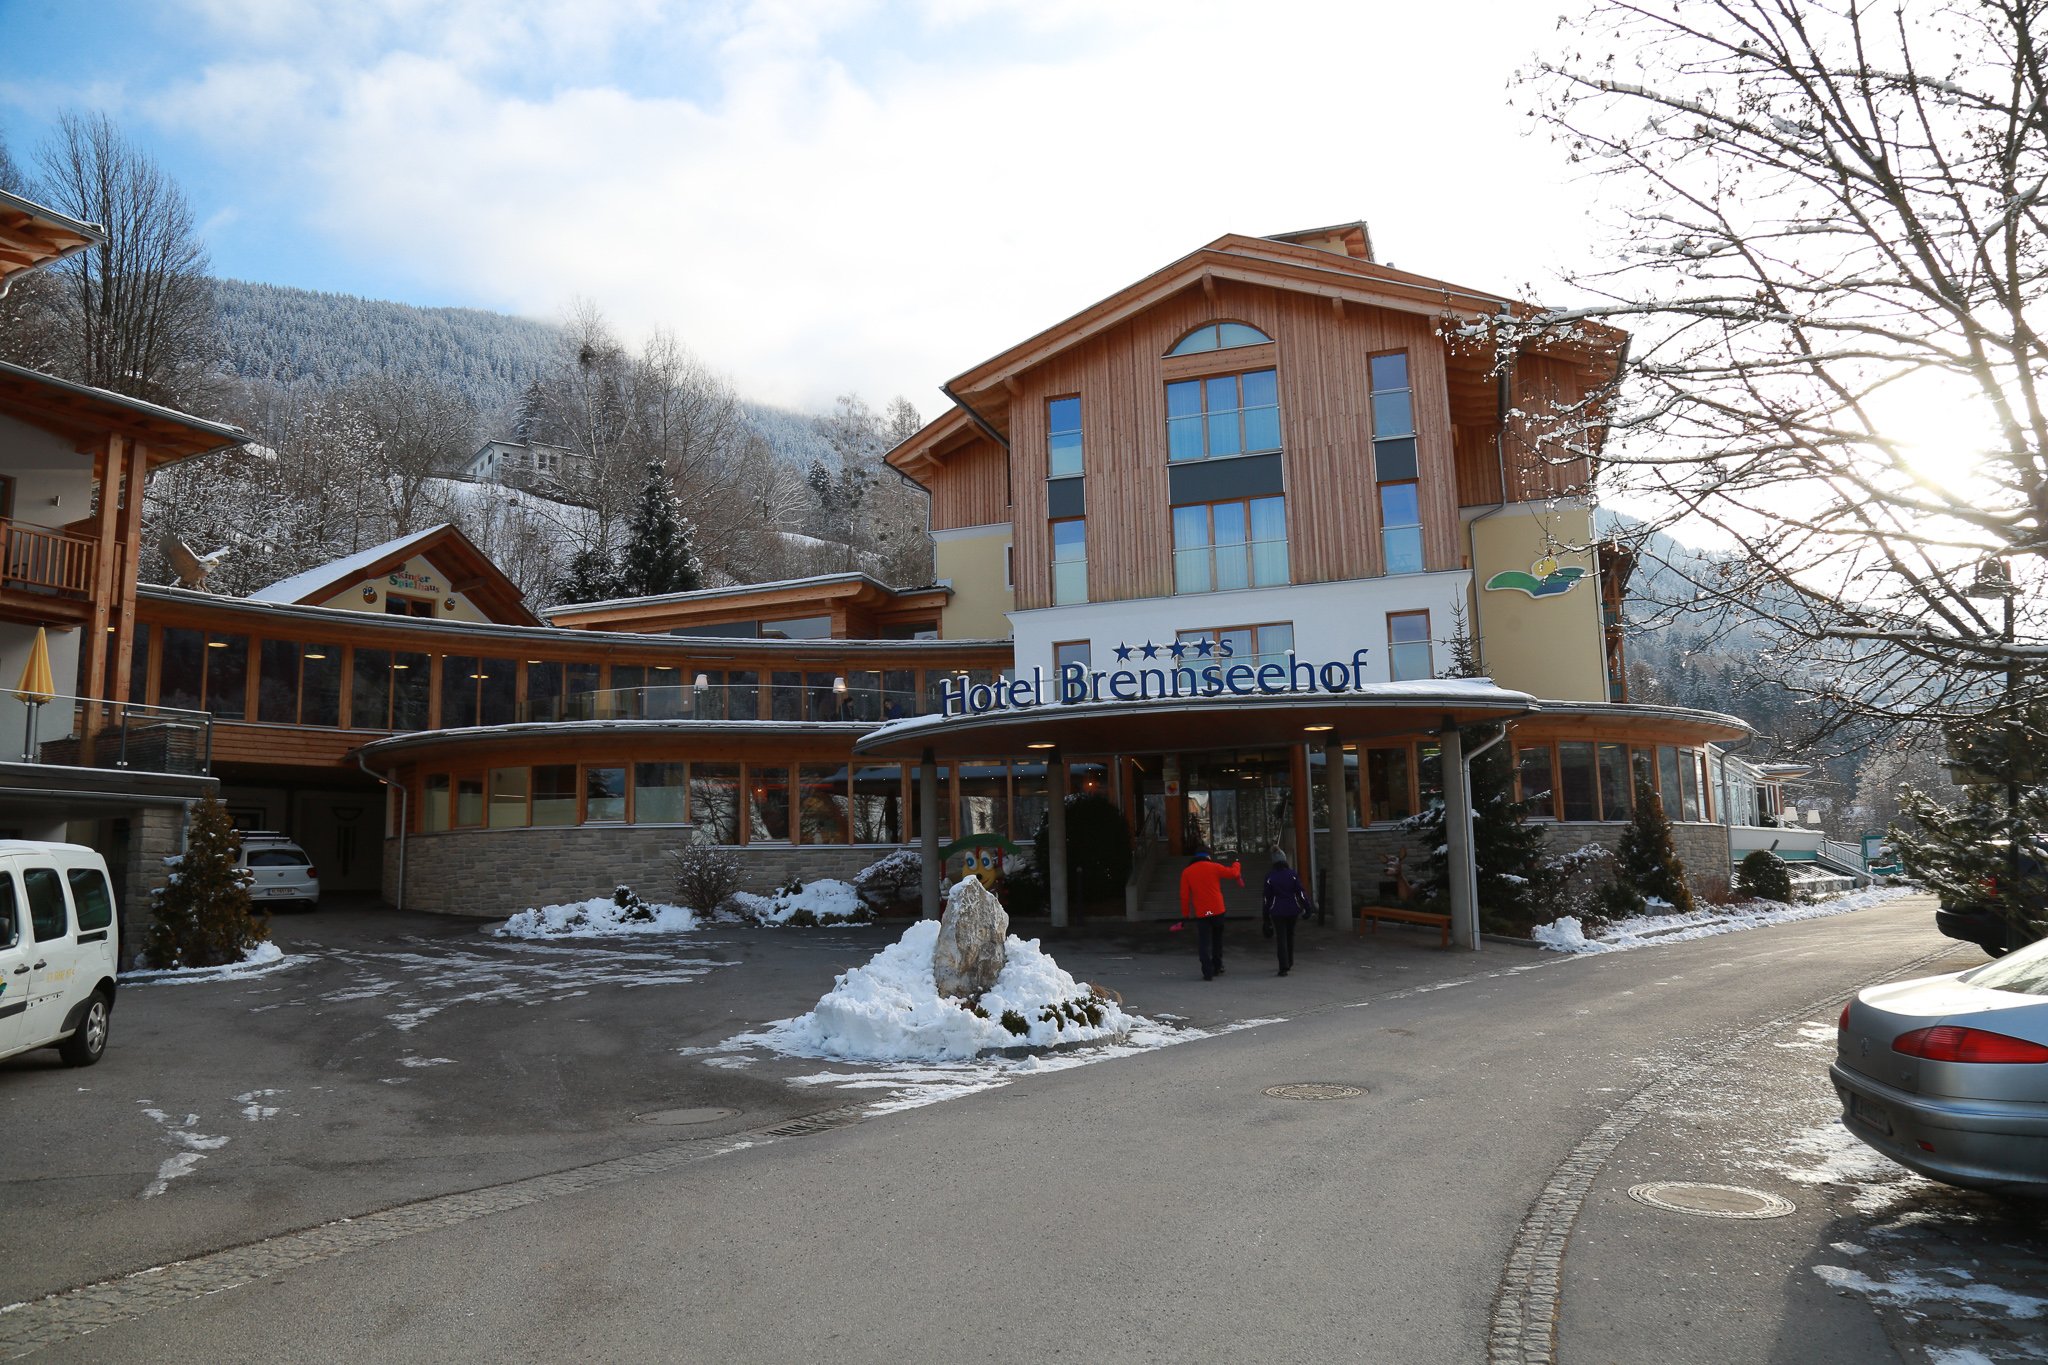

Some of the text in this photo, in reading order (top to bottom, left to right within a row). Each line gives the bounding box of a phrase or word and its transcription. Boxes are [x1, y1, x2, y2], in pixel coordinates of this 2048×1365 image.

[389, 574, 440, 593] Spielhaus
[940, 648, 1369, 718] Hotel Brennseehof
